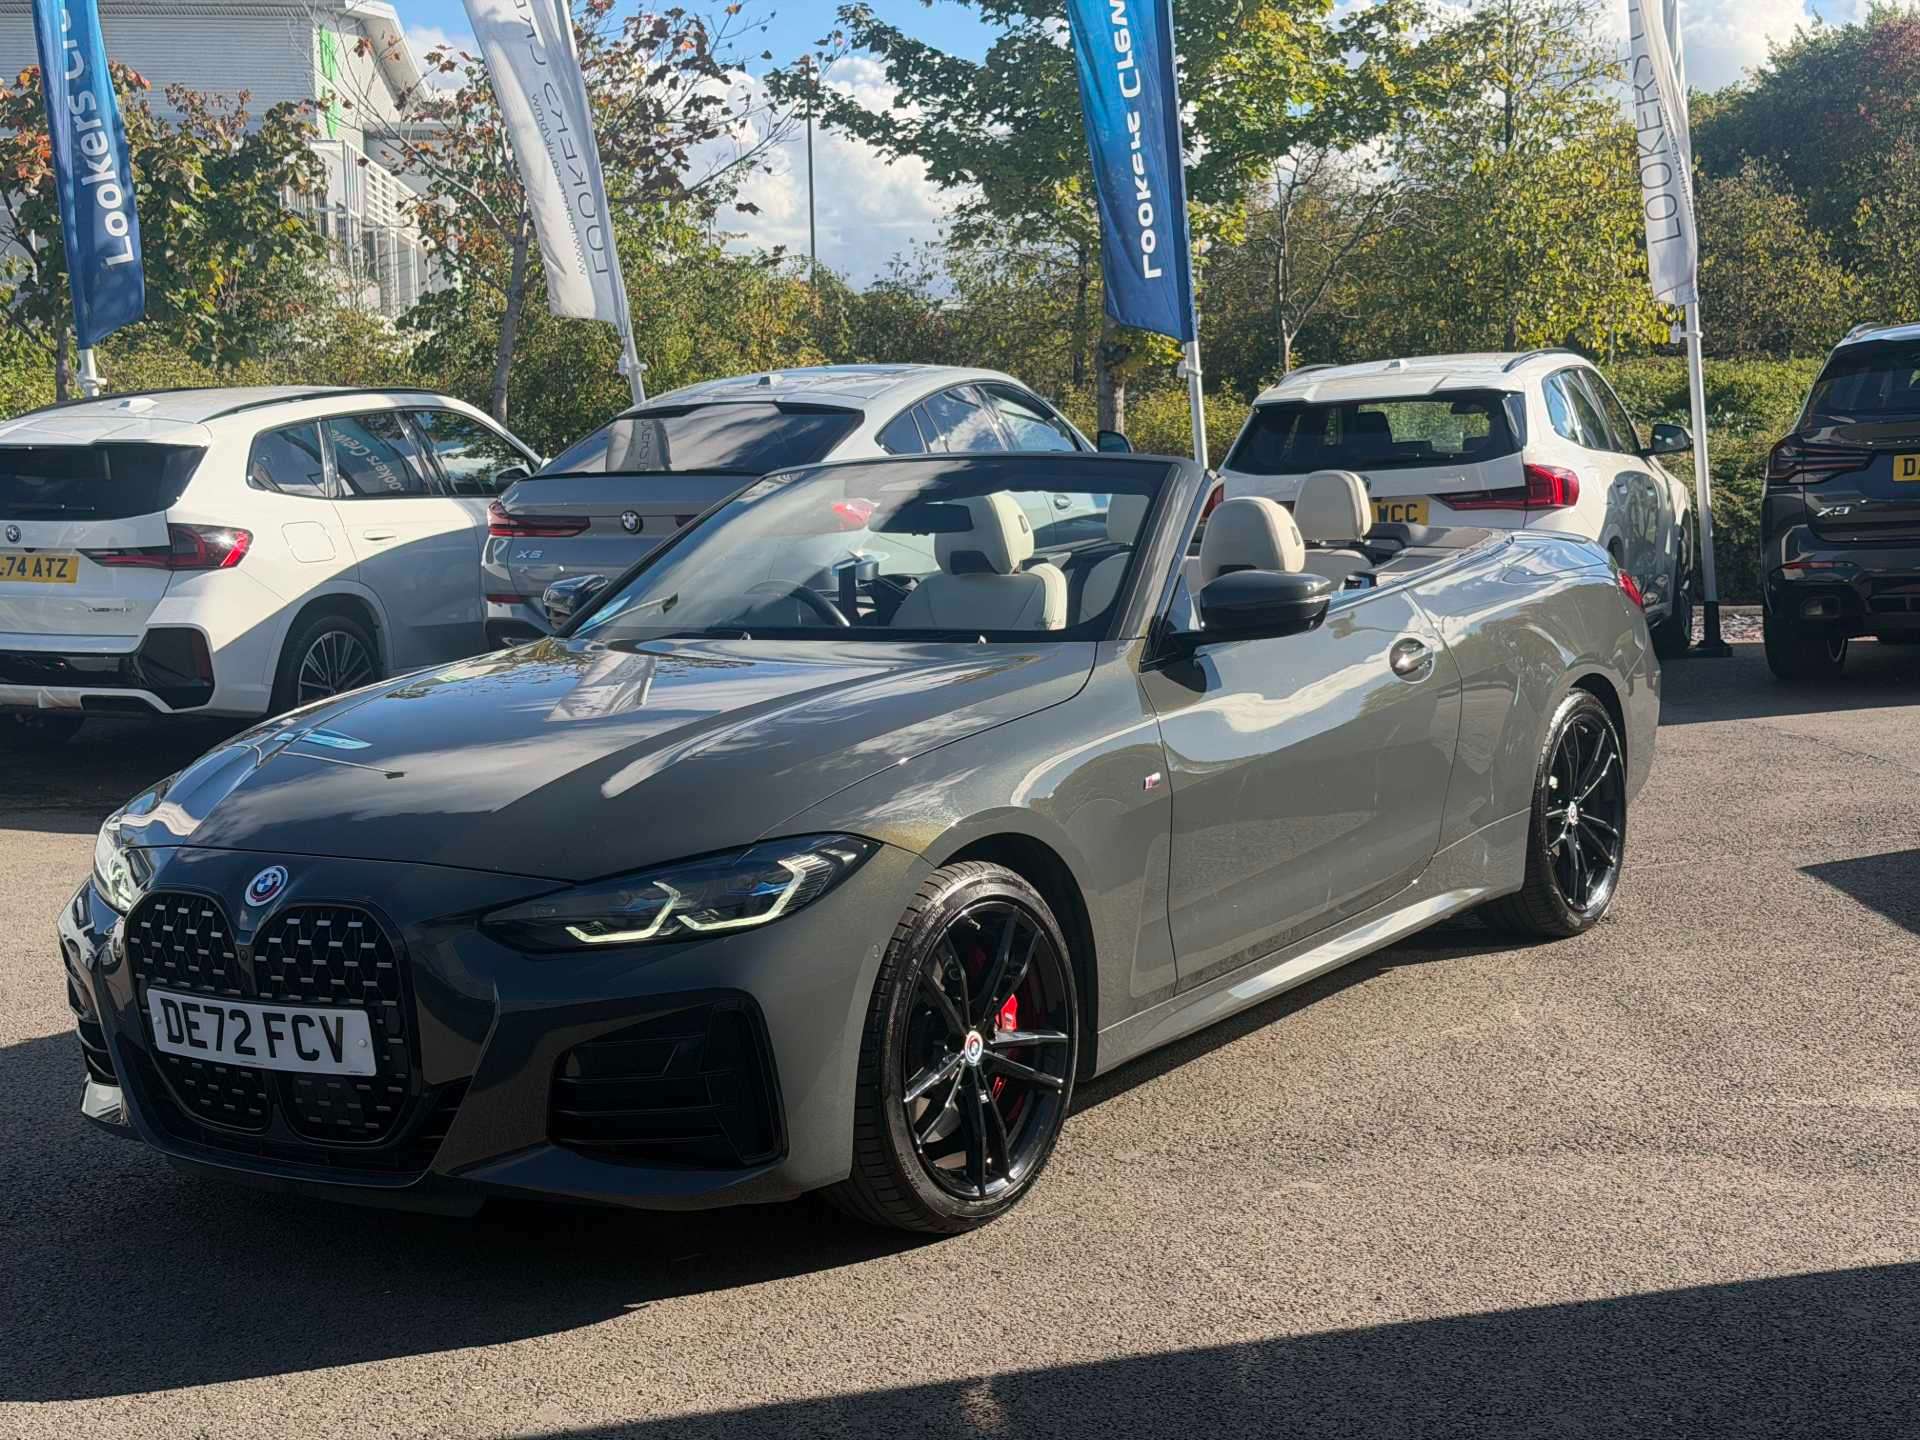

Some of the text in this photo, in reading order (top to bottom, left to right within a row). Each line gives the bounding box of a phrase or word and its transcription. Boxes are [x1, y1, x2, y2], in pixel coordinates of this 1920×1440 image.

[67, 89, 135, 266] Lookers
[1633, 54, 1682, 244] LOOKERS
[0, 556, 69, 578] 74 ATZ
[159, 997, 344, 1064] DE72 FCV
